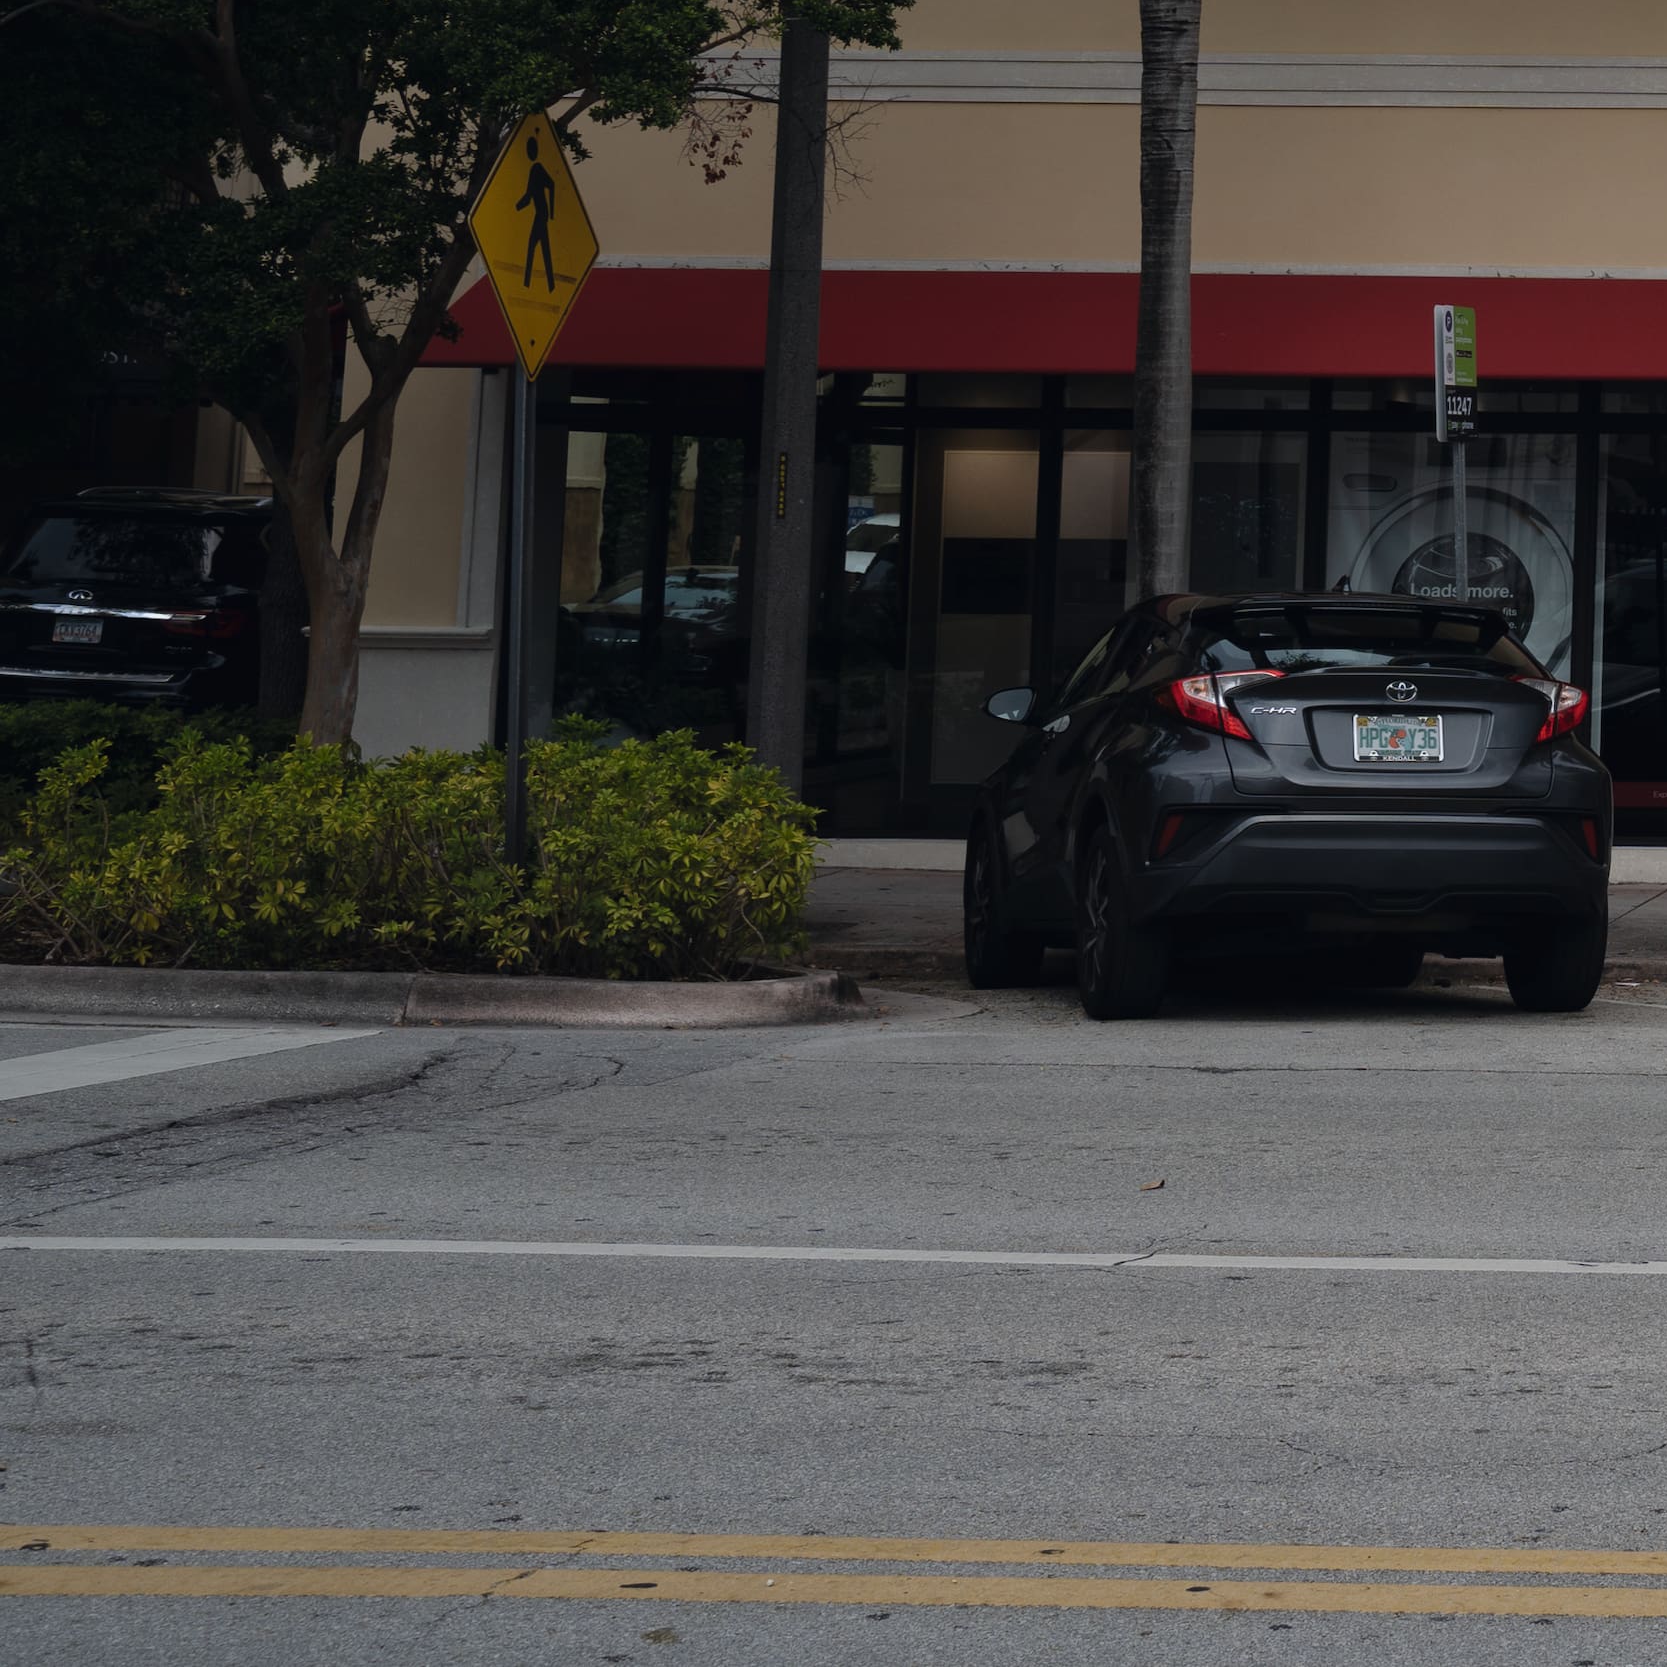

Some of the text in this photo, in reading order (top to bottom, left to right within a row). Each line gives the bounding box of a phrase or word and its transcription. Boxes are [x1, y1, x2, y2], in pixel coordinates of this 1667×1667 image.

[1447, 395, 1473, 416] 11247
[1467, 586, 1515, 599] more.
[1360, 727, 1437, 749] HPG Y36
